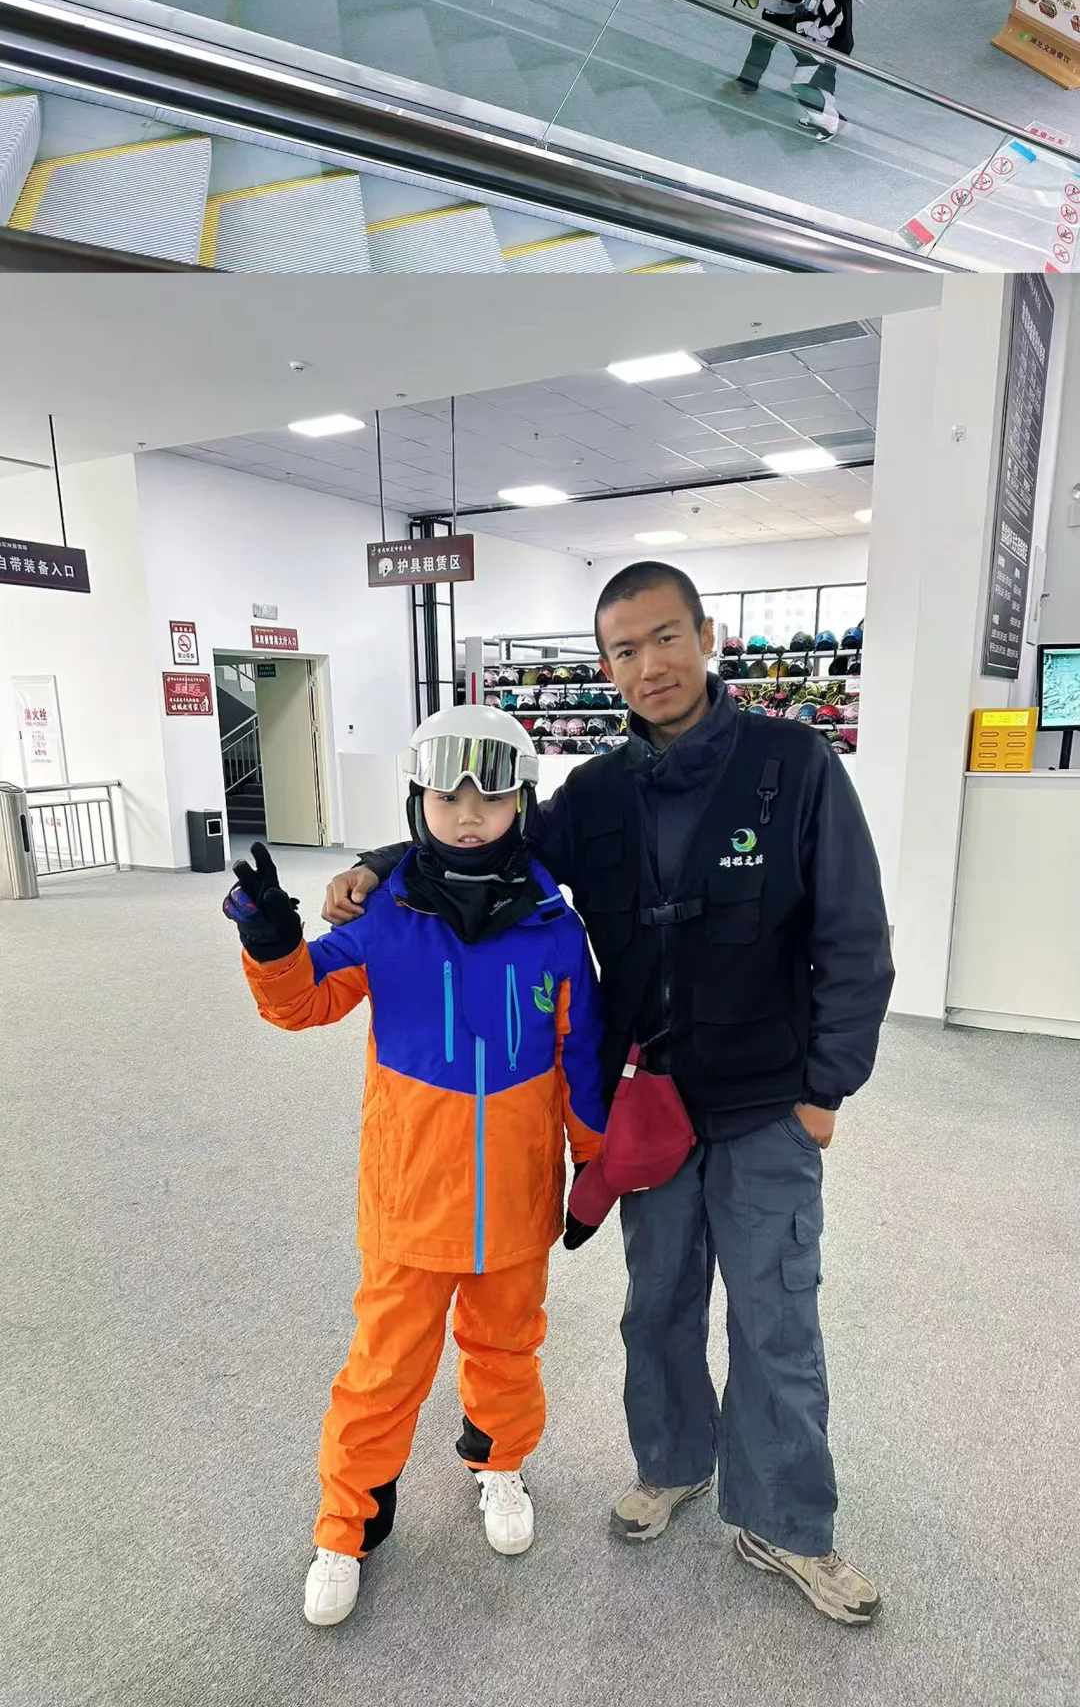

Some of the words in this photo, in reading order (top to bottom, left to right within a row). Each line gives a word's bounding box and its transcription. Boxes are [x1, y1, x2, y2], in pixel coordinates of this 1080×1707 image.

[0, 555, 75, 578] 自带装备入口
[397, 554, 461, 574] 护具租赁区
[25, 708, 48, 721] 消火栓
